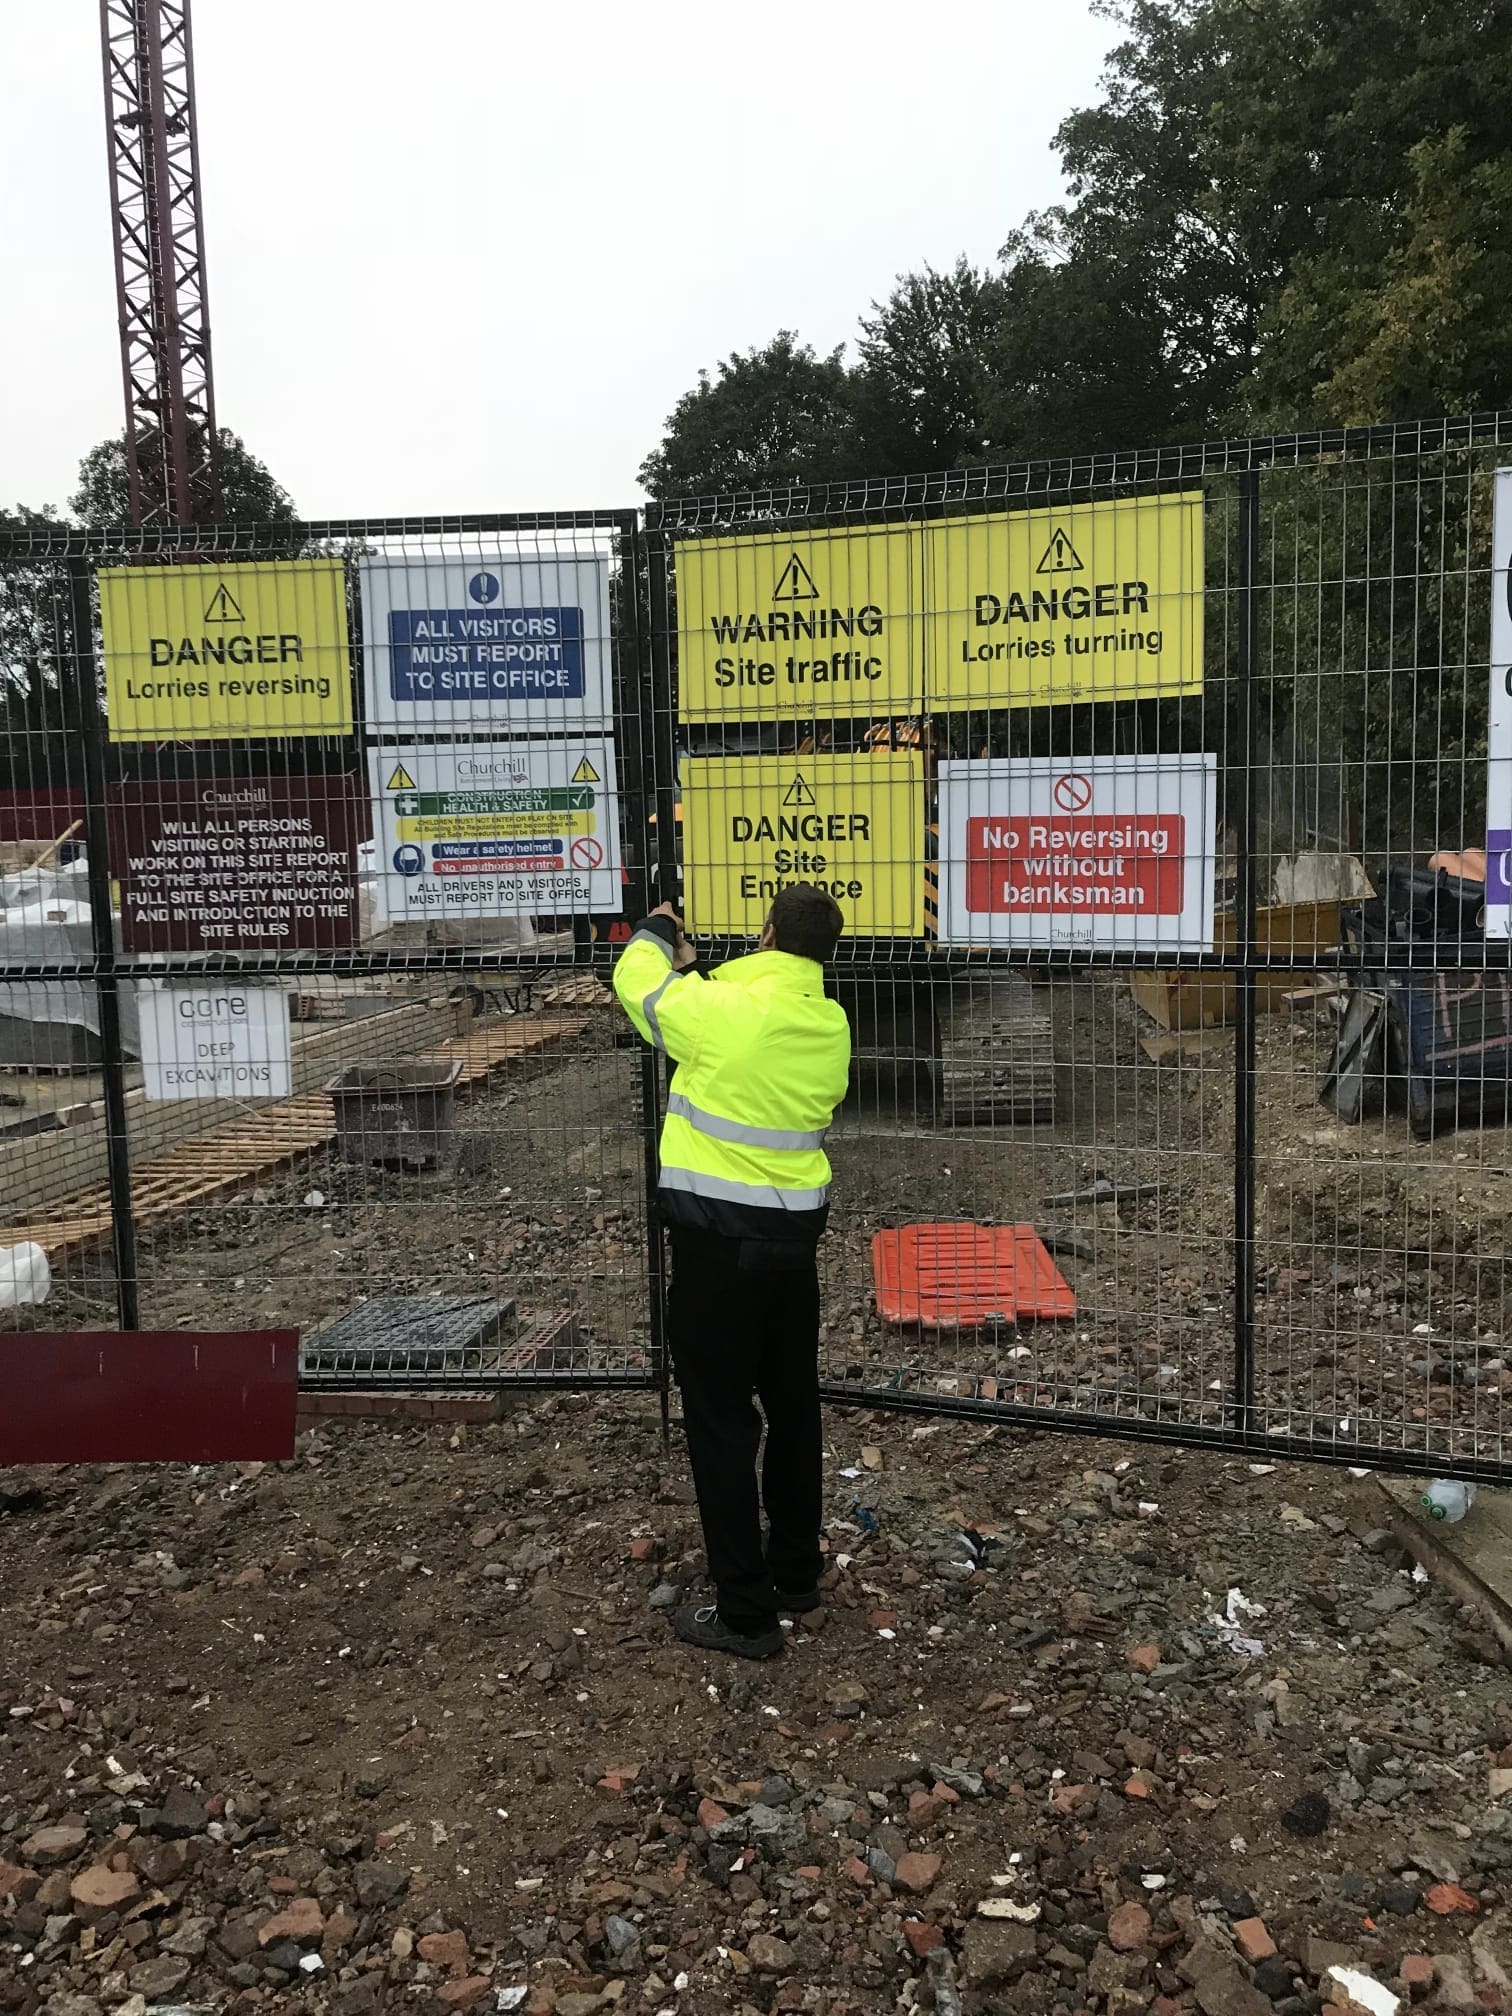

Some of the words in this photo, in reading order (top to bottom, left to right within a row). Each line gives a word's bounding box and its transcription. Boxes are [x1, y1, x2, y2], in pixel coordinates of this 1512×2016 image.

[975, 581, 1149, 627] DANGER
[416, 620, 454, 638] ALL
[459, 618, 557, 637] VISITORS
[711, 604, 884, 645] WARNING
[151, 635, 304, 667] DANGER
[413, 646, 471, 664] MUST
[477, 644, 562, 663] REPORT
[961, 639, 1056, 664] Lorries
[1063, 628, 1163, 655] turning
[406, 672, 434, 689] TO
[441, 671, 486, 689] SITE
[493, 669, 569, 688] OFFICE
[714, 657, 776, 688] Site
[785, 652, 883, 685] traffic
[127, 678, 209, 699] Lorries
[219, 674, 331, 699] reversing
[457, 757, 526, 775] Churchill
[447, 790, 542, 803] CONSTRUCTION
[443, 803, 488, 813] HEALTH
[503, 799, 548, 811] SAFETY
[162, 822, 200, 834] WILL
[204, 821, 235, 833] ALL
[238, 818, 312, 831] PERSONS
[732, 814, 870, 842] DANGER
[151, 838, 218, 852] VISITING
[222, 837, 245, 849] OR
[249, 835, 325, 849] STARTING
[443, 846, 470, 856] Wear
[516, 842, 553, 853] helmet
[983, 826, 1020, 850] No
[1029, 826, 1168, 855] Reversing
[129, 857, 179, 870] WORK
[182, 856, 206, 868] ON
[209, 855, 245, 867] THIS
[249, 854, 282, 866] SITE
[286, 852, 348, 865] REPORT
[441, 863, 456, 872] No
[774, 849, 828, 875] Site
[1024, 854, 1124, 877] without
[138, 874, 160, 887] TO
[165, 873, 195, 886] THE
[199, 872, 233, 884] SITE
[238, 871, 292, 884] OFFICE
[296, 870, 329, 883] FOR
[331, 870, 343, 882] A
[417, 883, 439, 893] ALL
[443, 881, 494, 892] DRIVERS
[499, 879, 523, 890] AND
[527, 877, 581, 889] VISITORS
[127, 892, 168, 905] FULL
[170, 890, 204, 903] SITE
[208, 888, 269, 902] SAFETY
[272, 886, 355, 900] INDUCTION
[409, 894, 442, 905] MUST
[446, 892, 494, 903] REPORT
[499, 892, 514, 901] TO
[519, 890, 544, 900] SITE
[548, 889, 591, 900] OFFICE
[1003, 881, 1145, 905] banksman
[136, 909, 169, 922] AND
[173, 906, 290, 920] INTRODUCTION
[295, 906, 315, 918] TO
[318, 904, 348, 917] THE
[200, 924, 235, 937] SITE
[238, 923, 289, 936] RULES
[198, 1042, 235, 1057] DEEP
[166, 1066, 270, 1084] EXCAVTIONS
